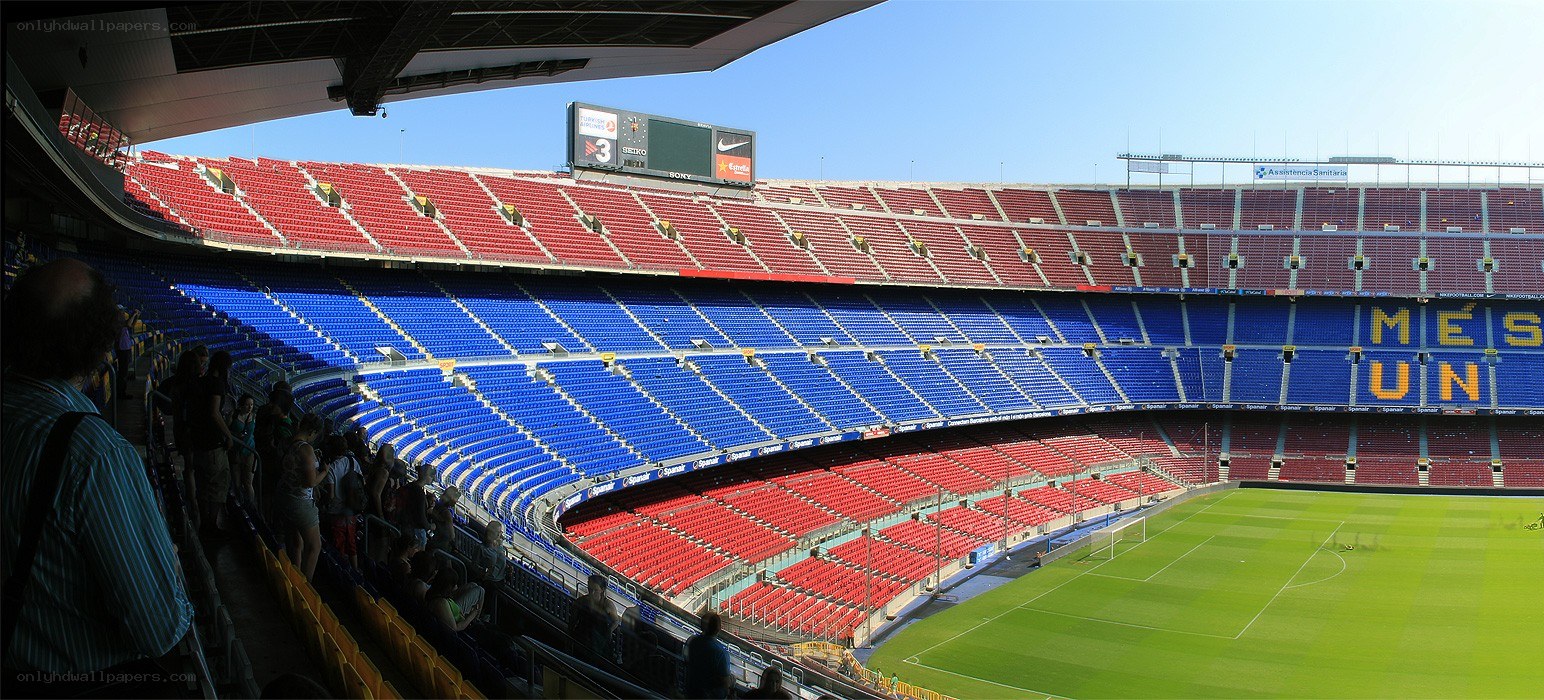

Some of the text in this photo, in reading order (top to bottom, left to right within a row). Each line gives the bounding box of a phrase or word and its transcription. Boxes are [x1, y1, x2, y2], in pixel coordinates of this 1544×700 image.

[580, 116, 604, 124] TURKISH
[580, 122, 604, 131] AIRLINES
[596, 139, 610, 162] 3
[622, 147, 646, 156] SEIKO
[729, 162, 749, 172] Estrella
[1370, 302, 1543, 348] MÉS
[1369, 360, 1480, 402] UN
[899, 424, 916, 433] Spanair
[926, 421, 944, 430] Spanair
[794, 438, 813, 447] Spanair
[824, 435, 842, 444] Spanair
[763, 444, 783, 454] Spanair
[731, 450, 751, 460] Spanair
[699, 457, 719, 468] Spanair
[664, 464, 686, 476] Spanair
[629, 472, 650, 485] Spanair
[592, 482, 615, 496] Spanair
